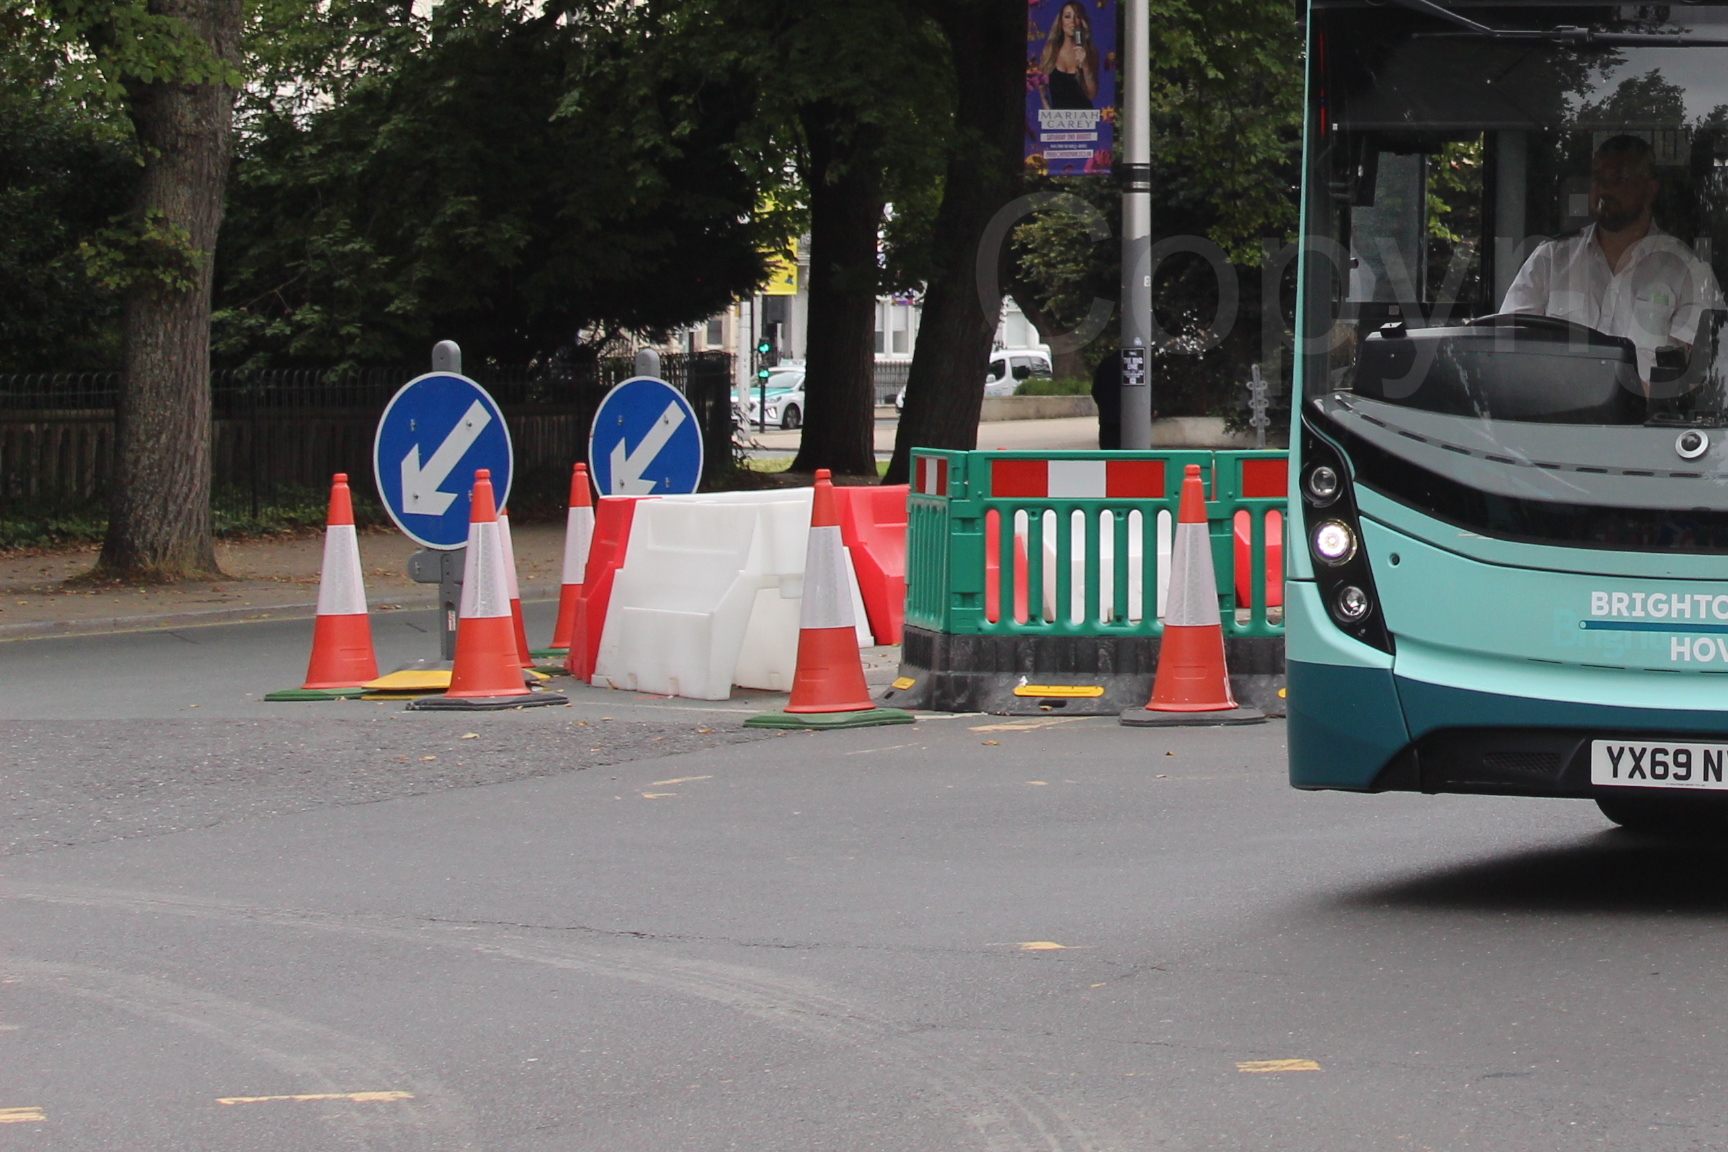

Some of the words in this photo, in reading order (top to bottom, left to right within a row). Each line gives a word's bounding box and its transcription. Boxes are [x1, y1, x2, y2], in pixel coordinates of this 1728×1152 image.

[1040, 111, 1099, 120] MARIAH
[1047, 120, 1093, 128] CAREY
[1606, 745, 1692, 781] YX69
